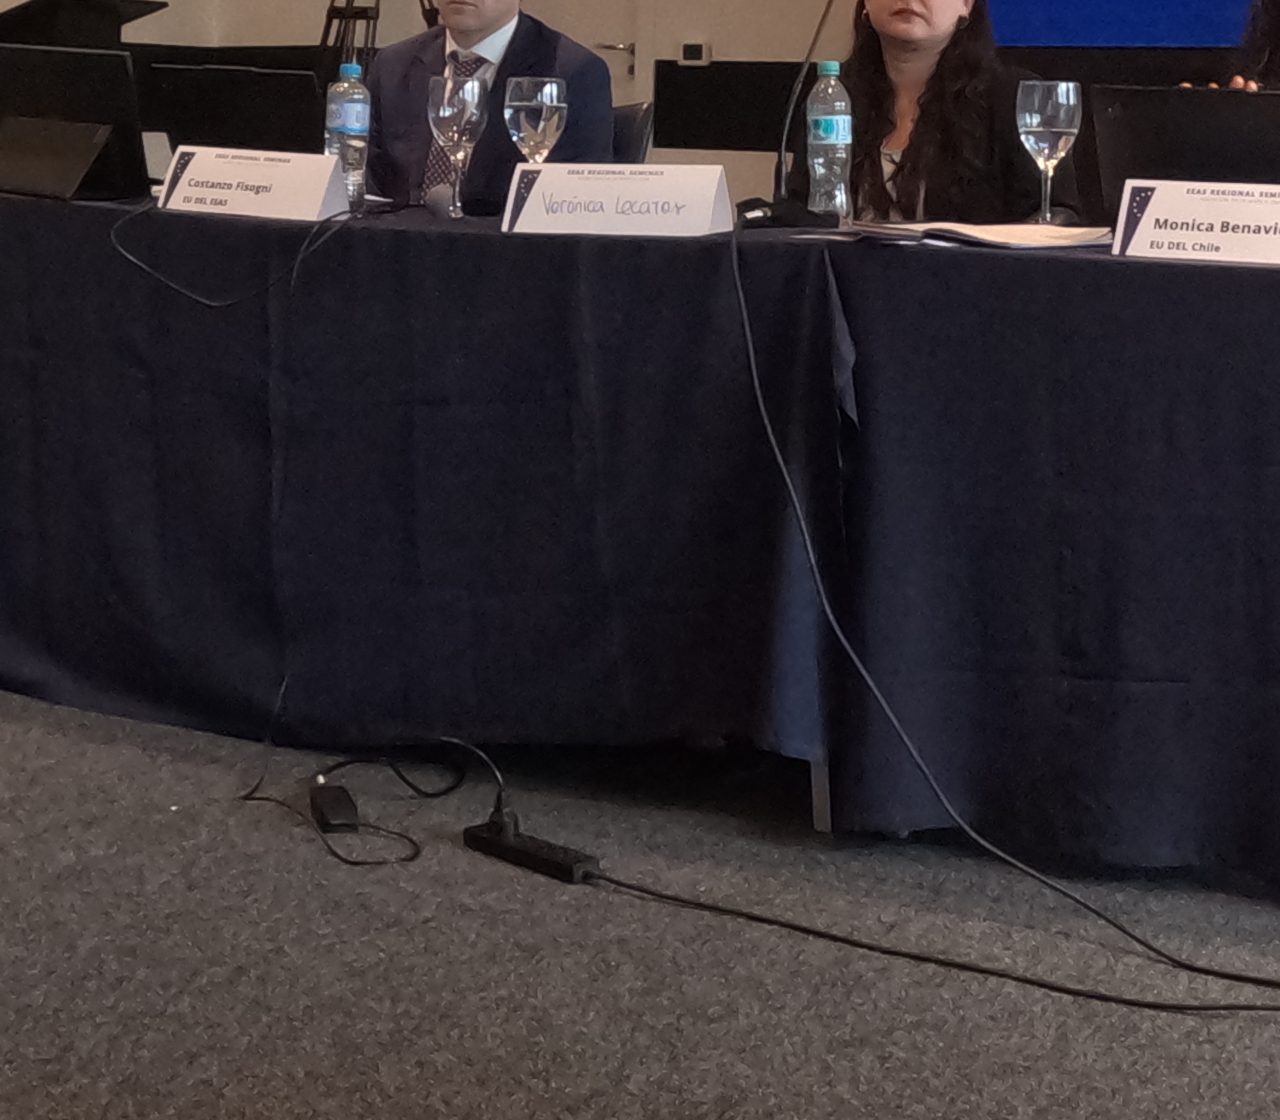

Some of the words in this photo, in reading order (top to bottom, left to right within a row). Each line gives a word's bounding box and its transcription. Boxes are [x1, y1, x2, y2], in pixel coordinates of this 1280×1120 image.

[187, 178, 234, 191] Costanzo
[235, 181, 273, 196] Fisogni
[1186, 188, 1208, 196] EEAS
[1210, 189, 1256, 198] REGIONAL
[182, 195, 193, 204] EU
[194, 196, 209, 206] DEL
[1152, 218, 1215, 234] Monica
[1149, 240, 1165, 250] EU
[1167, 241, 1188, 252] DEL
[1191, 243, 1221, 254] Chile
